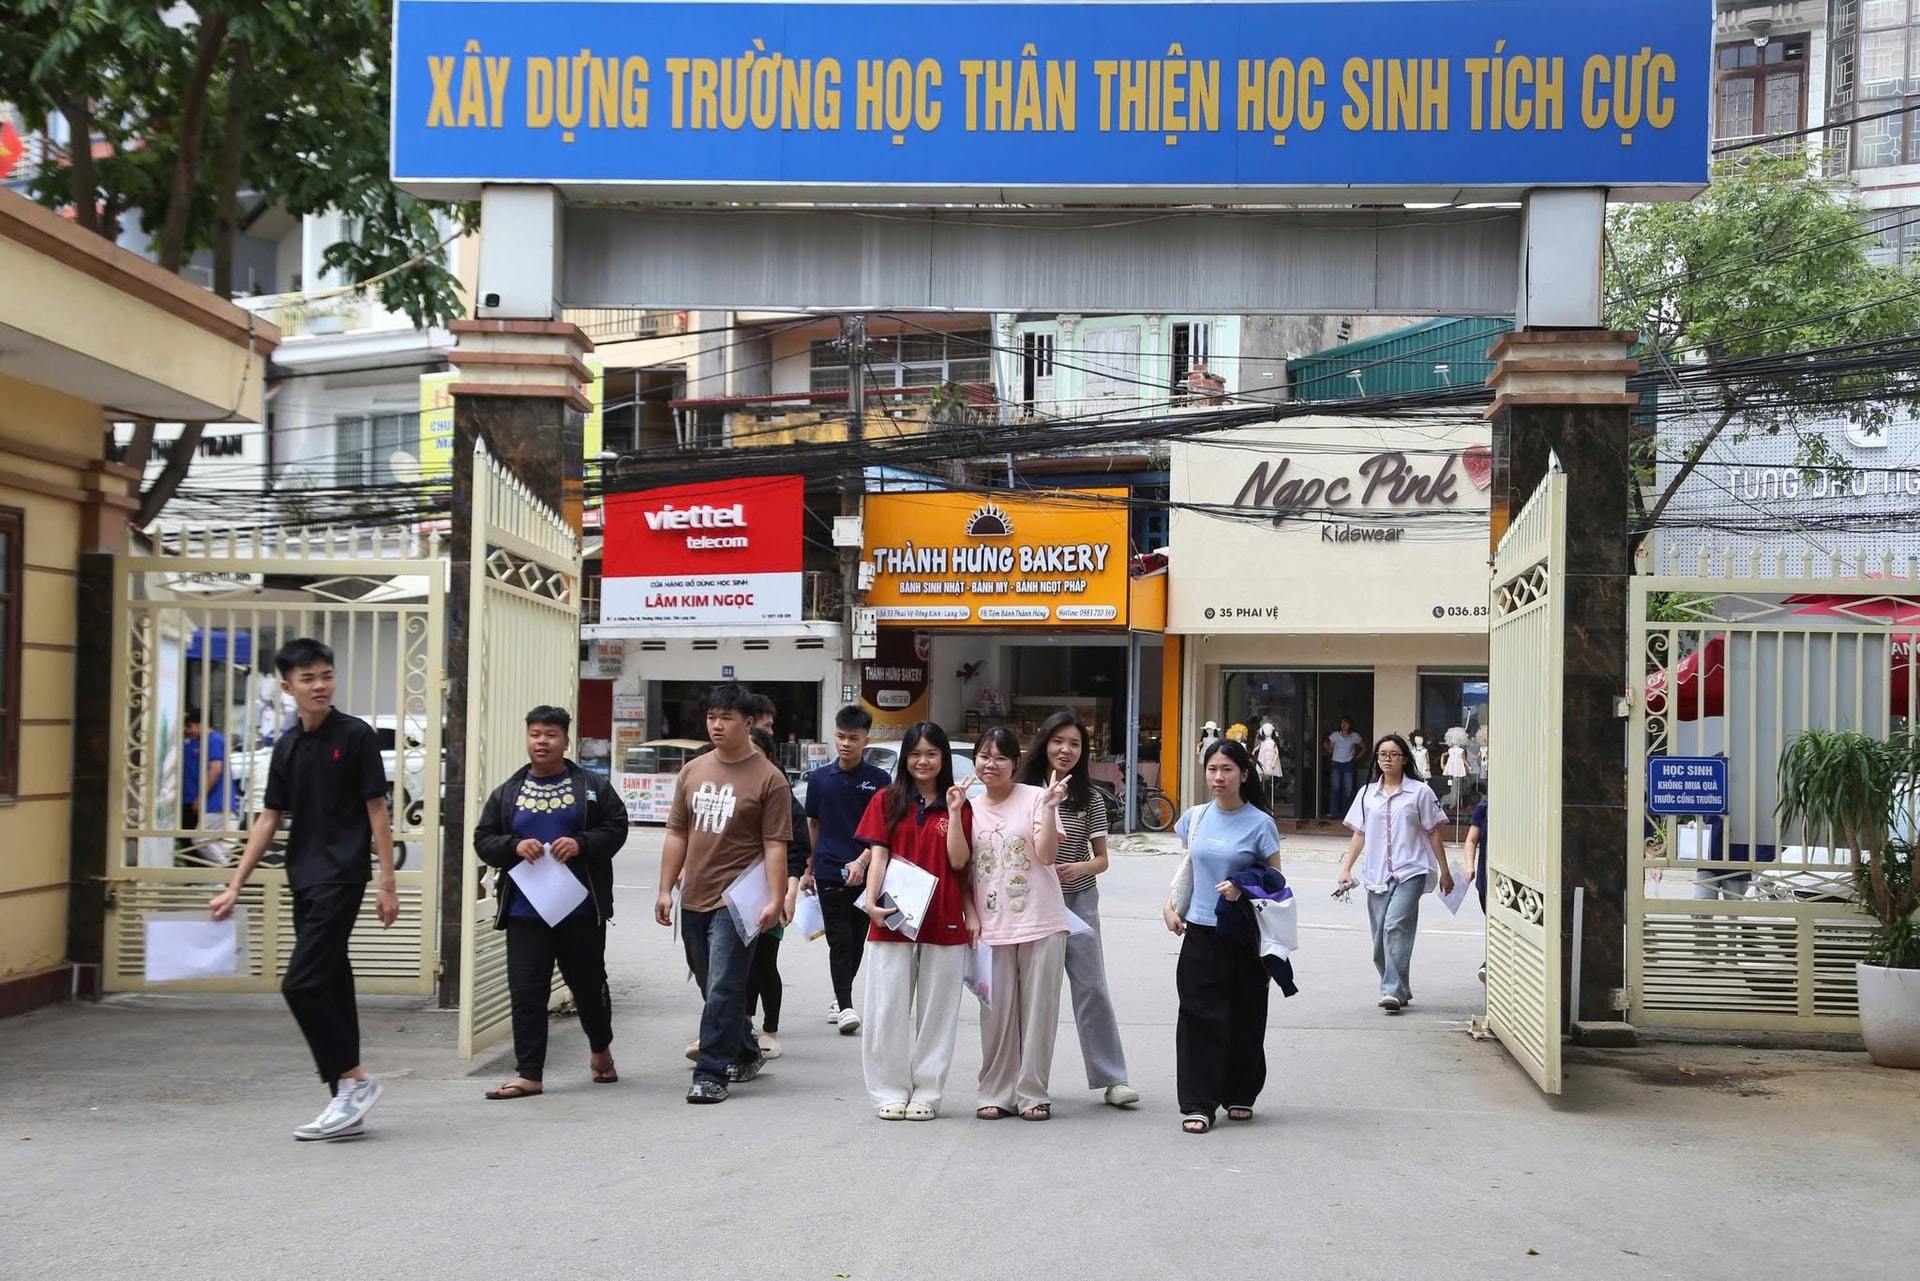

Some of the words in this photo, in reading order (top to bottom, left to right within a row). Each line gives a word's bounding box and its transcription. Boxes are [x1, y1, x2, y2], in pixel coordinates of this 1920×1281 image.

[426, 39, 511, 128] XÂY
[526, 48, 650, 143] DỰNG
[666, 38, 842, 130] TRƯỜNG
[856, 57, 943, 145] HỌC
[959, 42, 1077, 132] THÂN
[1094, 42, 1220, 146] THIỆN
[1237, 57, 1326, 146] HỌC
[1342, 57, 1449, 131] SINH
[1465, 39, 1564, 130] TÍCH
[1581, 46, 1676, 145] CỰC
[1360, 451, 1458, 505] Pink
[644, 503, 747, 530] viettel
[1321, 524, 1405, 542] Kidswear
[686, 536, 748, 550] telecom
[872, 541, 946, 574] THÀNH
[951, 544, 1015, 574] HƯNG
[1019, 543, 1110, 574] BAKERY
[899, 579, 921, 593] BÁNH
[923, 581, 942, 593] SINH
[944, 579, 965, 595] NHẬT
[971, 579, 993, 593] BÁNH
[1016, 579, 1039, 593] BÁNH
[1040, 580, 1062, 595] NGỌT
[1064, 578, 1087, 593] PHÁP
[645, 592, 677, 608] LÂM
[681, 594, 709, 607] KIM
[713, 593, 754, 609] NGỌC
[1219, 608, 1232, 618] 35
[1236, 608, 1262, 618] PHAI
[1266, 605, 1279, 619] VỆ
[1663, 765, 1684, 777] HỌC
[1687, 765, 1713, 776] SINH
[1657, 779, 1683, 790] KHÔNG
[1685, 781, 1701, 790] MUA
